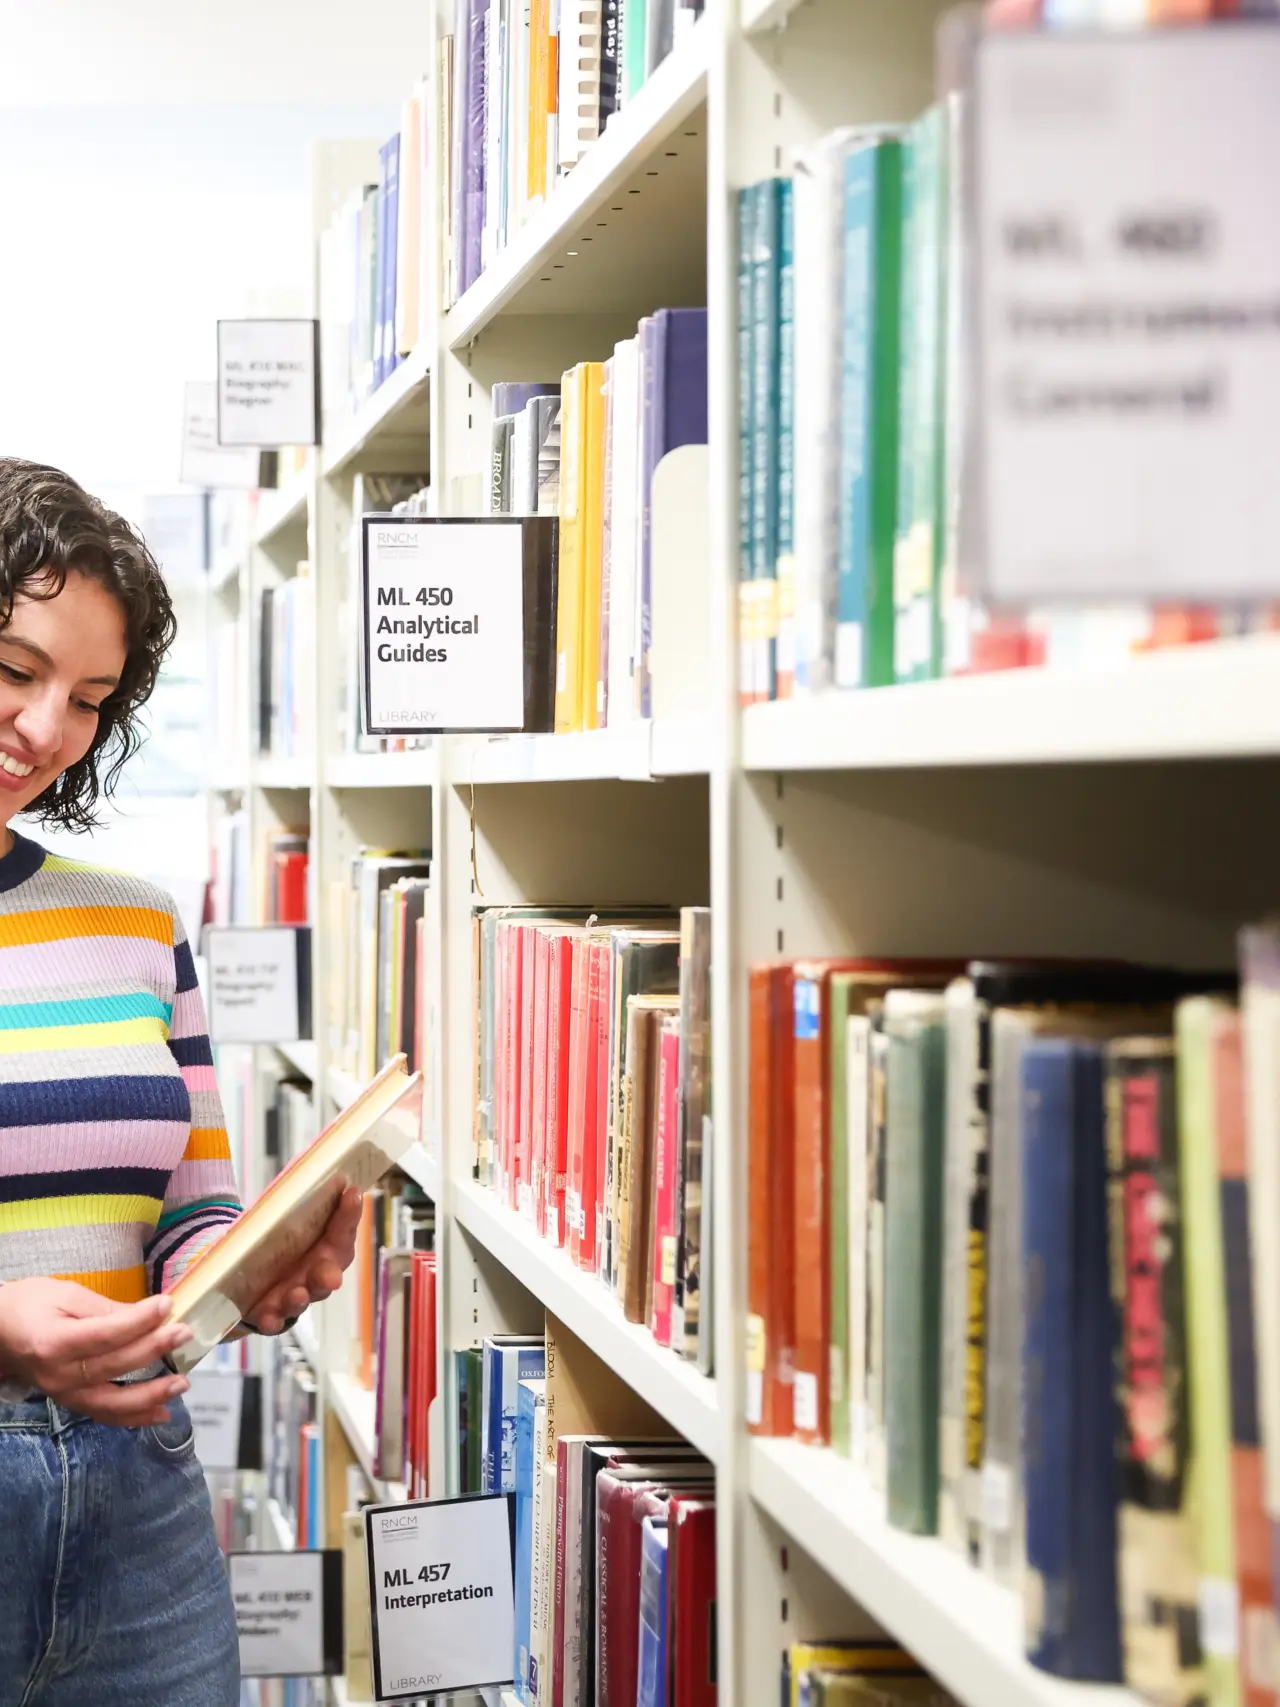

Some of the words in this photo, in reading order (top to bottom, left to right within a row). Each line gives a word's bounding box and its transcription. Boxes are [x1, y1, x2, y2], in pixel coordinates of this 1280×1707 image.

[605, 17, 617, 58] play
[377, 532, 419, 544] RNCM
[377, 587, 410, 606] ML
[415, 587, 454, 606] 450
[376, 614, 479, 639] Analytical
[377, 643, 448, 662] Guides
[379, 710, 438, 723] LIBRARY
[658, 1057, 668, 1134] CONCERT
[656, 1136, 666, 1189] GUIDE
[547, 1339, 556, 1379] BLOOM
[547, 1394, 555, 1416] THE
[547, 1419, 555, 1440] ART
[547, 1444, 555, 1461] OF
[381, 1515, 418, 1529] RNCM
[555, 1495, 564, 1535] Playing
[556, 1535, 564, 1562] with
[383, 1568, 414, 1588] ML
[417, 1562, 451, 1583] 457
[543, 1543, 551, 1585] HISTORY
[600, 1535, 608, 1608] CLASSICAL
[384, 1584, 494, 1610] Interpretation
[542, 1587, 549, 1601] OF
[555, 1563, 563, 1606] History
[541, 1603, 549, 1633] MUSIC
[600, 1610, 608, 1623] &
[600, 1624, 608, 1699] ROMANTIC
[389, 1673, 443, 1691] LIBRARY
